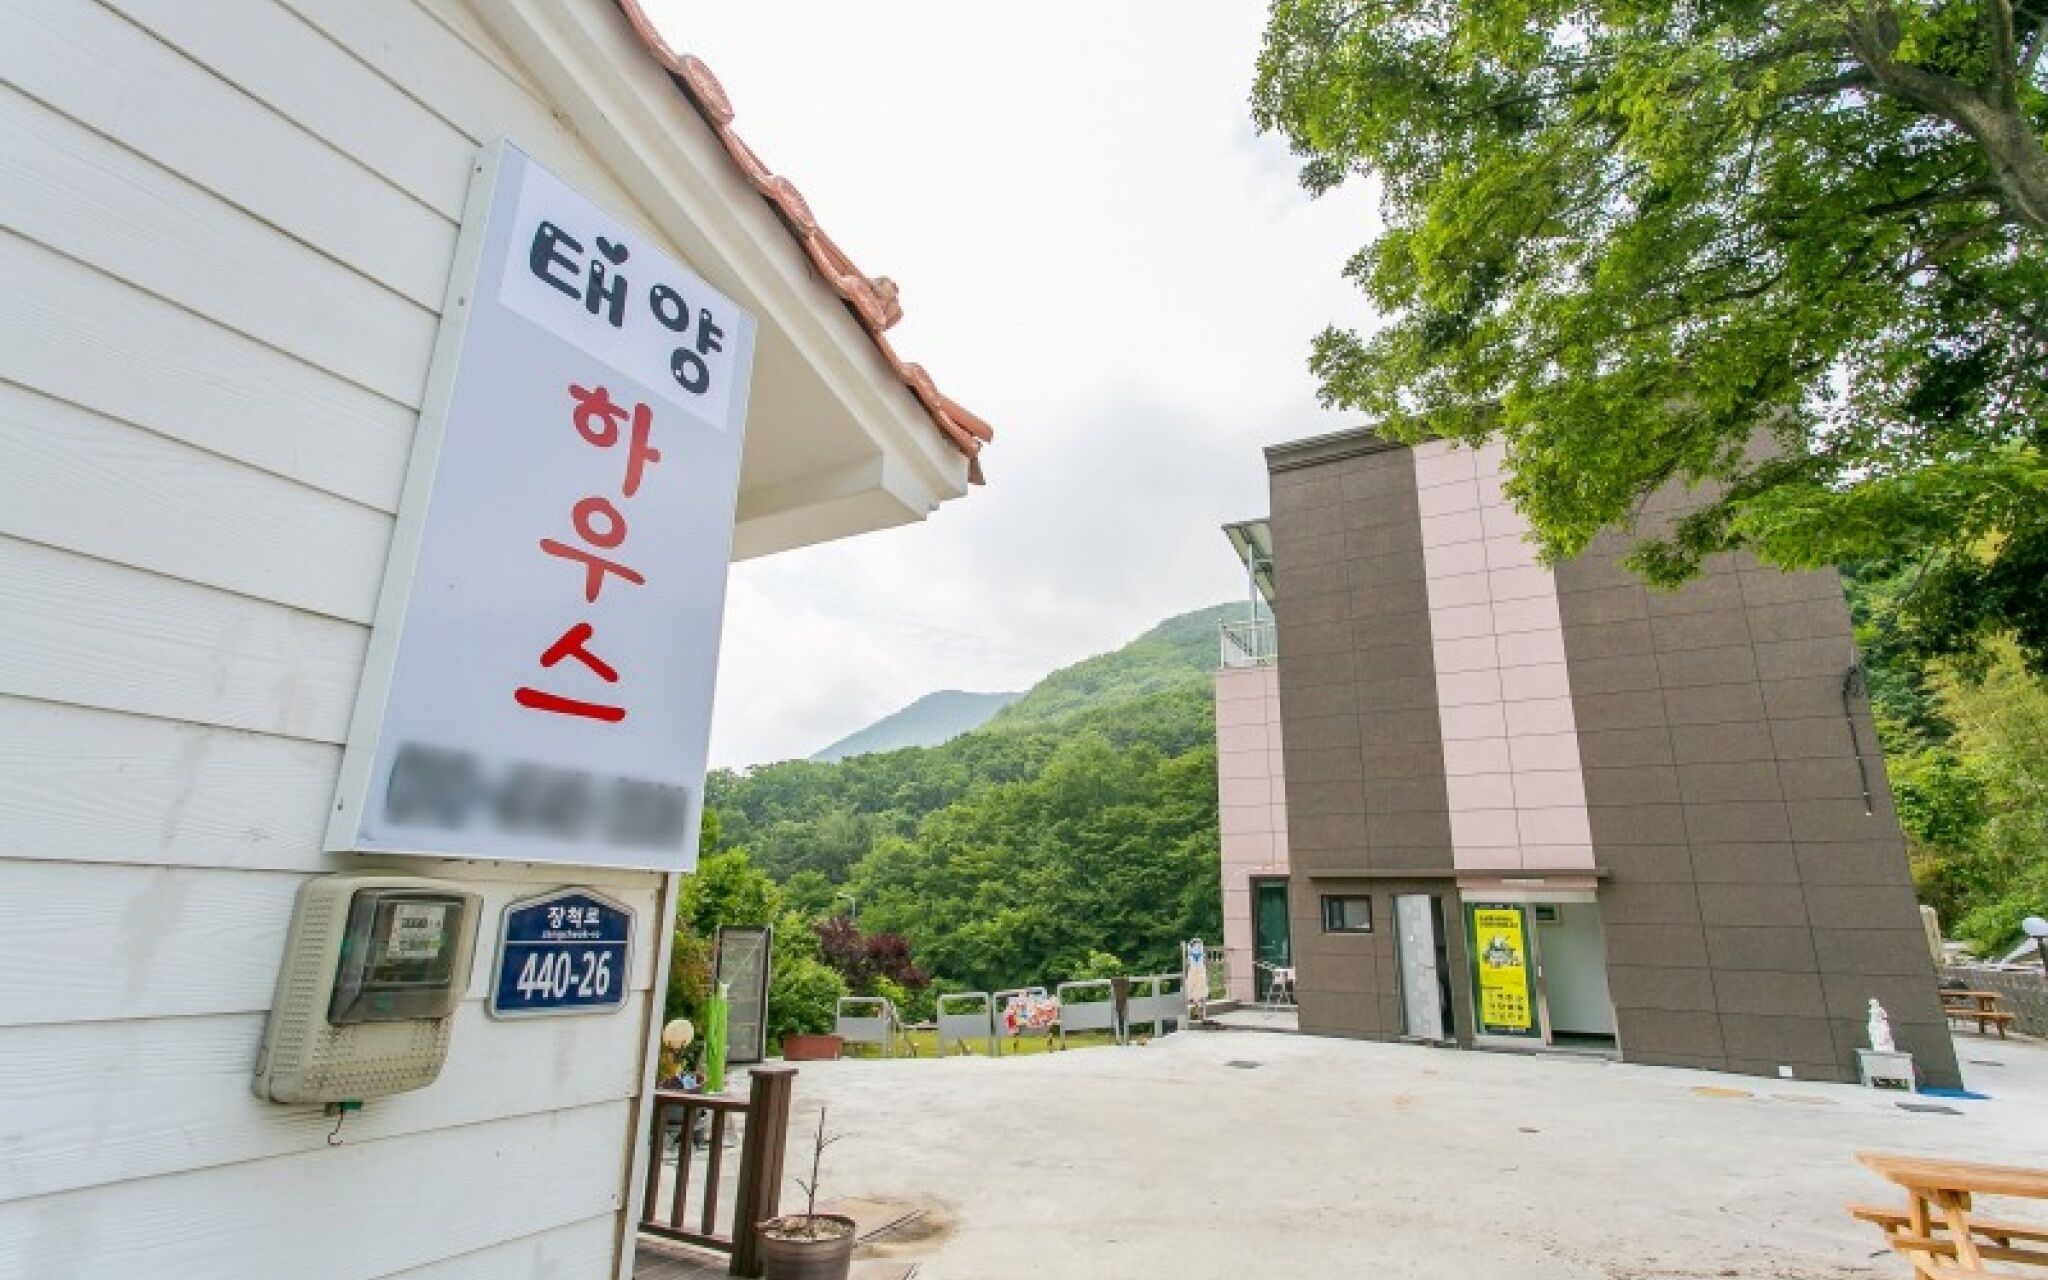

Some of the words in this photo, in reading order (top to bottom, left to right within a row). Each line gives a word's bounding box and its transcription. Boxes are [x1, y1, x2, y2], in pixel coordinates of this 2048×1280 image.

[529, 221, 724, 394] 태양
[513, 385, 661, 724] 하우스
[547, 906, 600, 929] 장척로
[517, 951, 612, 1000] 440-26
